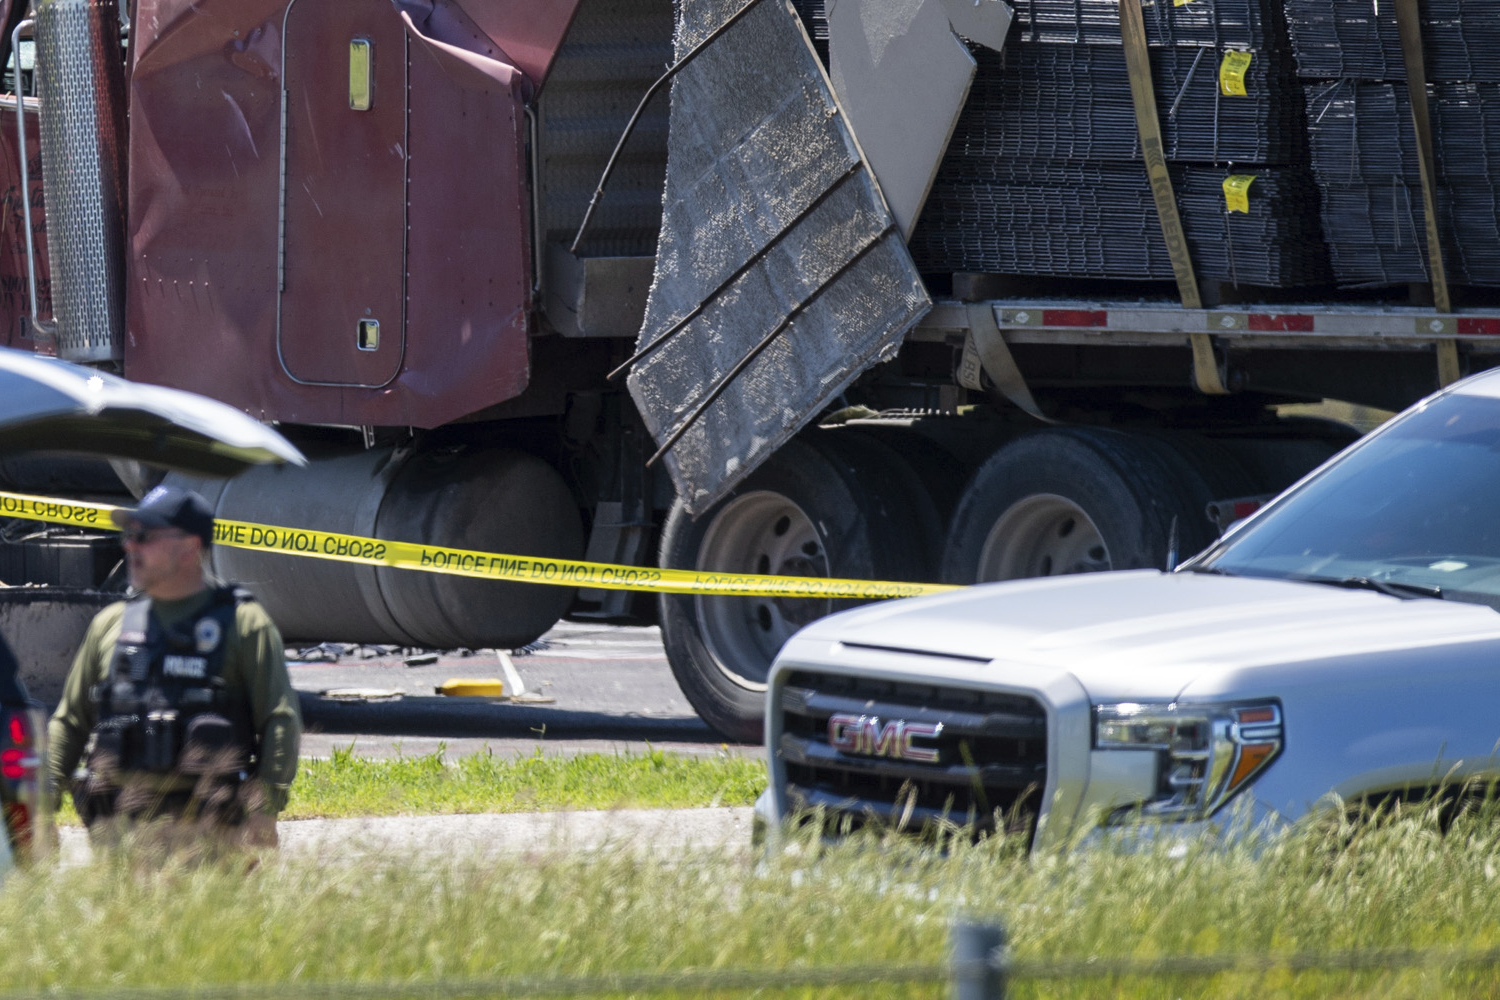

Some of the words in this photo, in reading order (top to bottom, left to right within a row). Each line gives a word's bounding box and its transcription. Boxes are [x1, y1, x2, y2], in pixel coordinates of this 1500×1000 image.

[1153, 176, 1197, 301] KINEDYNE
[162, 654, 208, 679] POLICE
[828, 712, 943, 763] GMC
